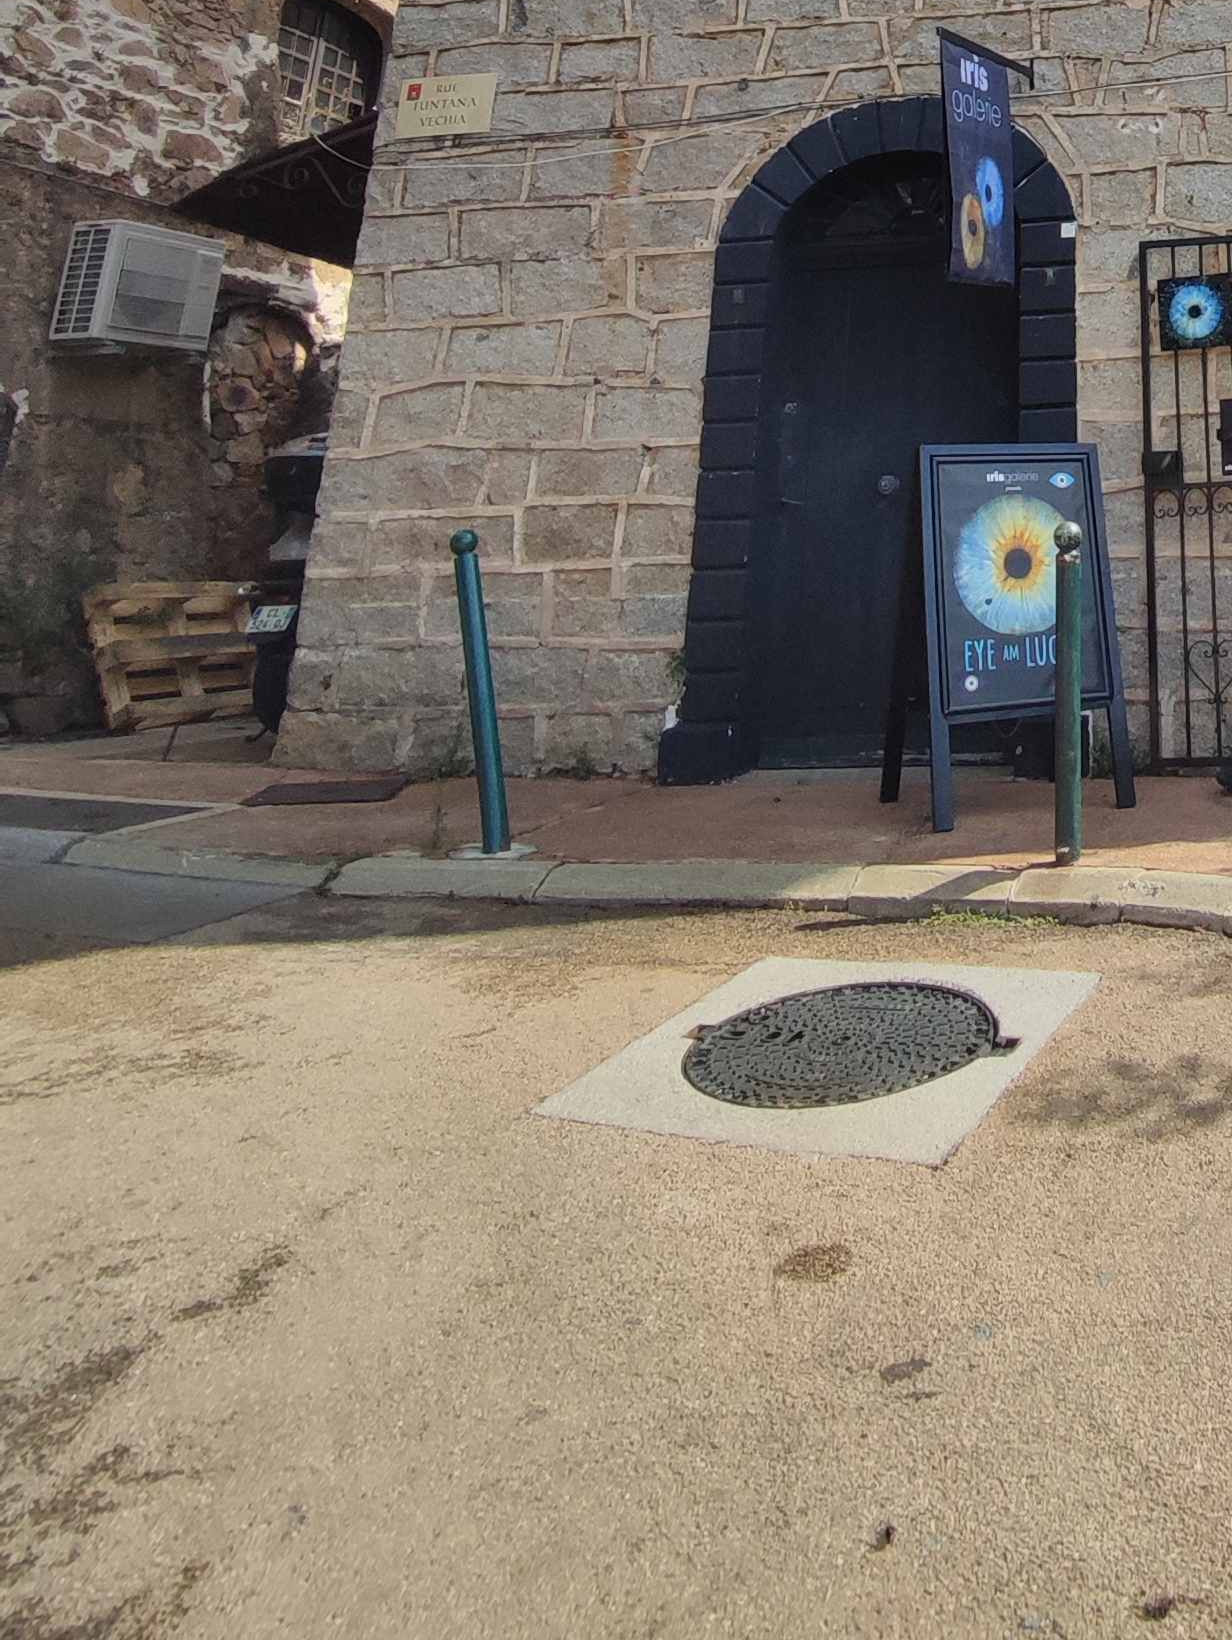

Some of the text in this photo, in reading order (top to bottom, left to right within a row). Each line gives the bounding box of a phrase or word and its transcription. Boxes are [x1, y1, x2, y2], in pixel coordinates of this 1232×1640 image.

[436, 83, 458, 93] RUE
[413, 97, 477, 112] FUNTANA
[951, 89, 1002, 128] galerie
[419, 114, 466, 127] VECHIA
[964, 634, 1057, 672] EYE AM LUC
